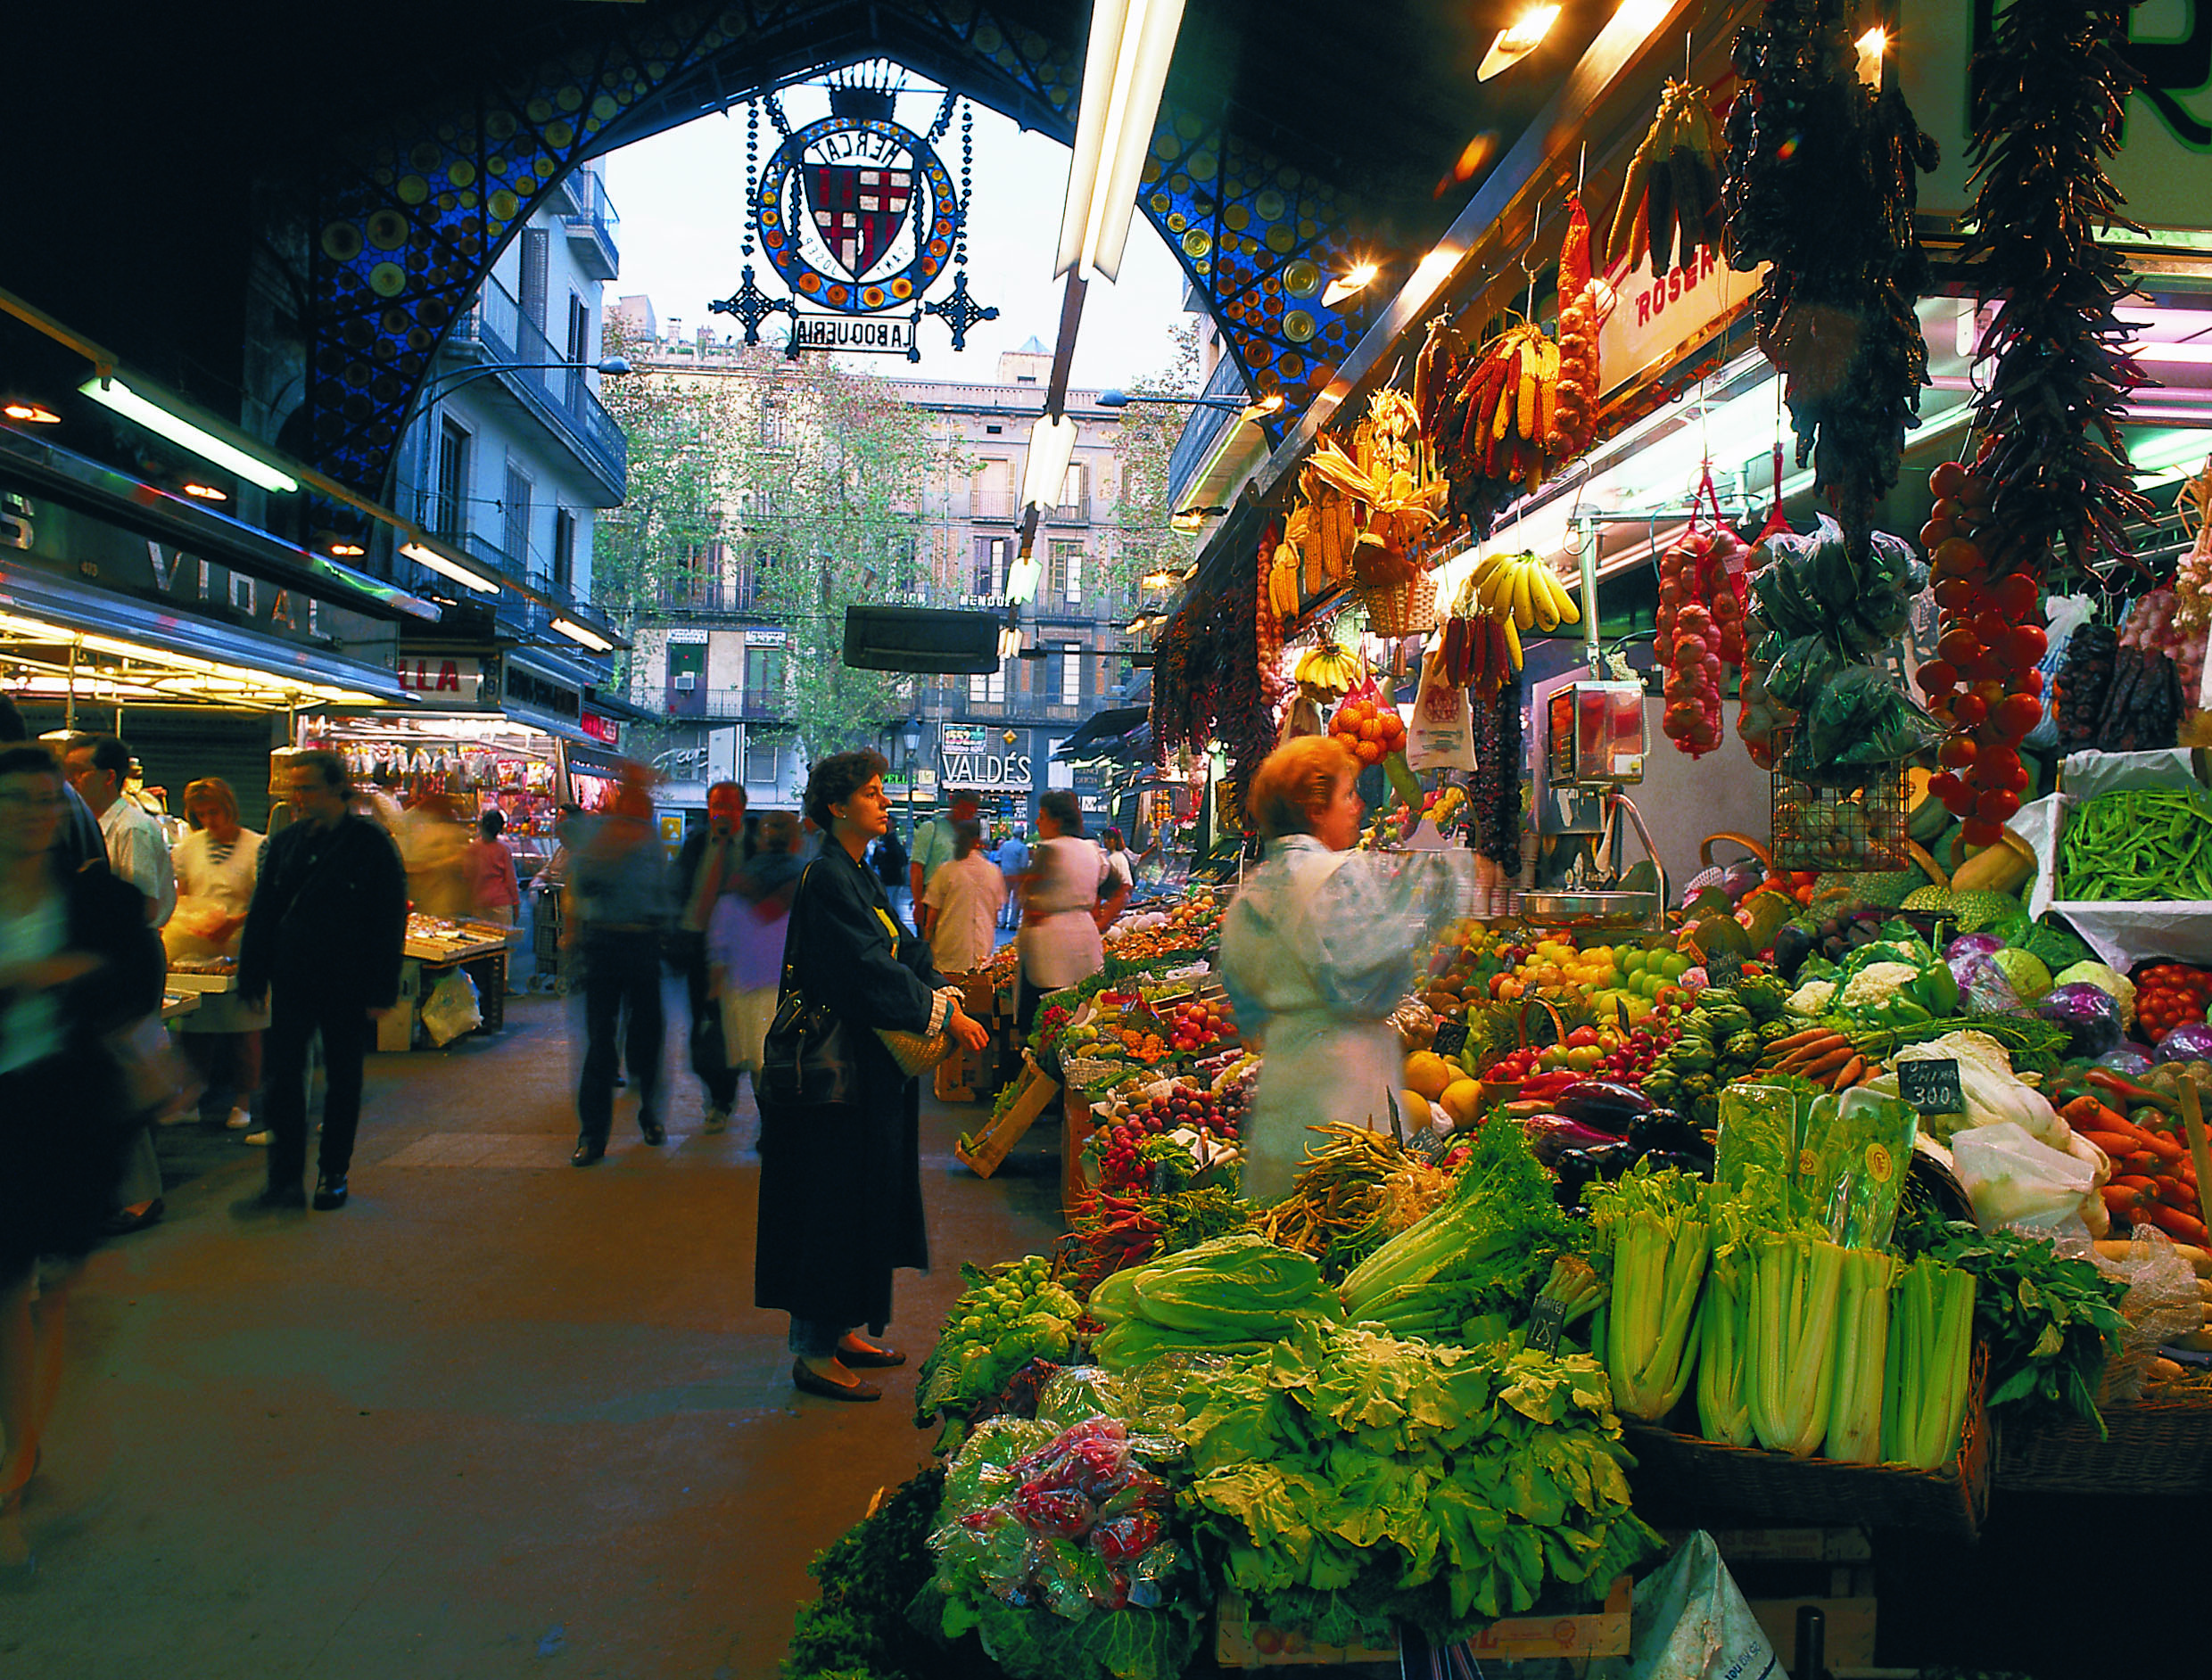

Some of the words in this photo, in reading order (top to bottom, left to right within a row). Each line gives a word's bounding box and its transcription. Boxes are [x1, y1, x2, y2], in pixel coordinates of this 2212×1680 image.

[147, 539, 333, 641] VIDAL
[942, 751, 1032, 784] VALDÉS
[1911, 1085, 1951, 1106] 300
